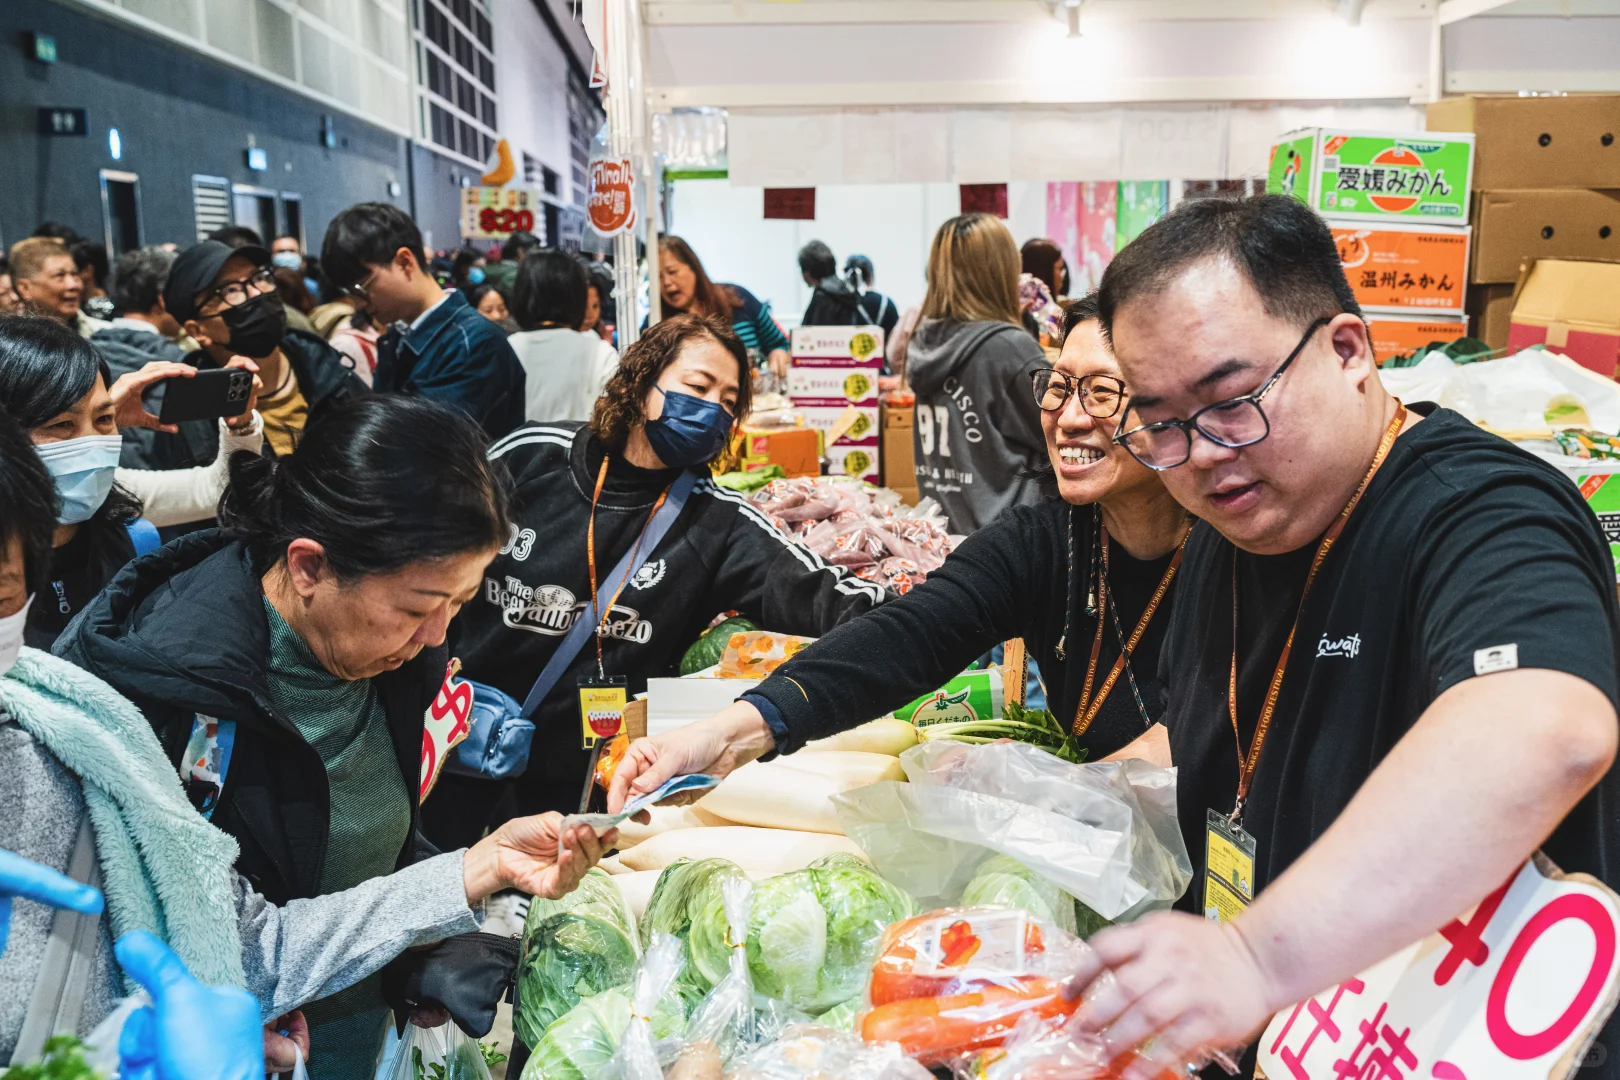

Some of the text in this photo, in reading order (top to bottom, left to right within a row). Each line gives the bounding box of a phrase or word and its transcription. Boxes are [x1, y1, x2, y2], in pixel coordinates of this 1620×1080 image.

[1337, 166, 1450, 197] 愛媛みかん
[480, 208, 533, 232] $20
[1360, 270, 1454, 291] 温州みかん
[943, 376, 983, 443] CISCO
[1382, 417, 1403, 446] FESTIVAL
[505, 575, 534, 600] The
[1126, 566, 1176, 652] HONG KONG FOOD FESTIVAL
[1080, 692, 1089, 710] FOOD
[1085, 659, 1096, 690] FESTIVAL
[1107, 667, 1120, 685] HONG
[1097, 685, 1110, 703] KONG
[1086, 702, 1099, 720] FOOD
[1246, 667, 1285, 773] HONG KONG FOOD FESTIVAL
